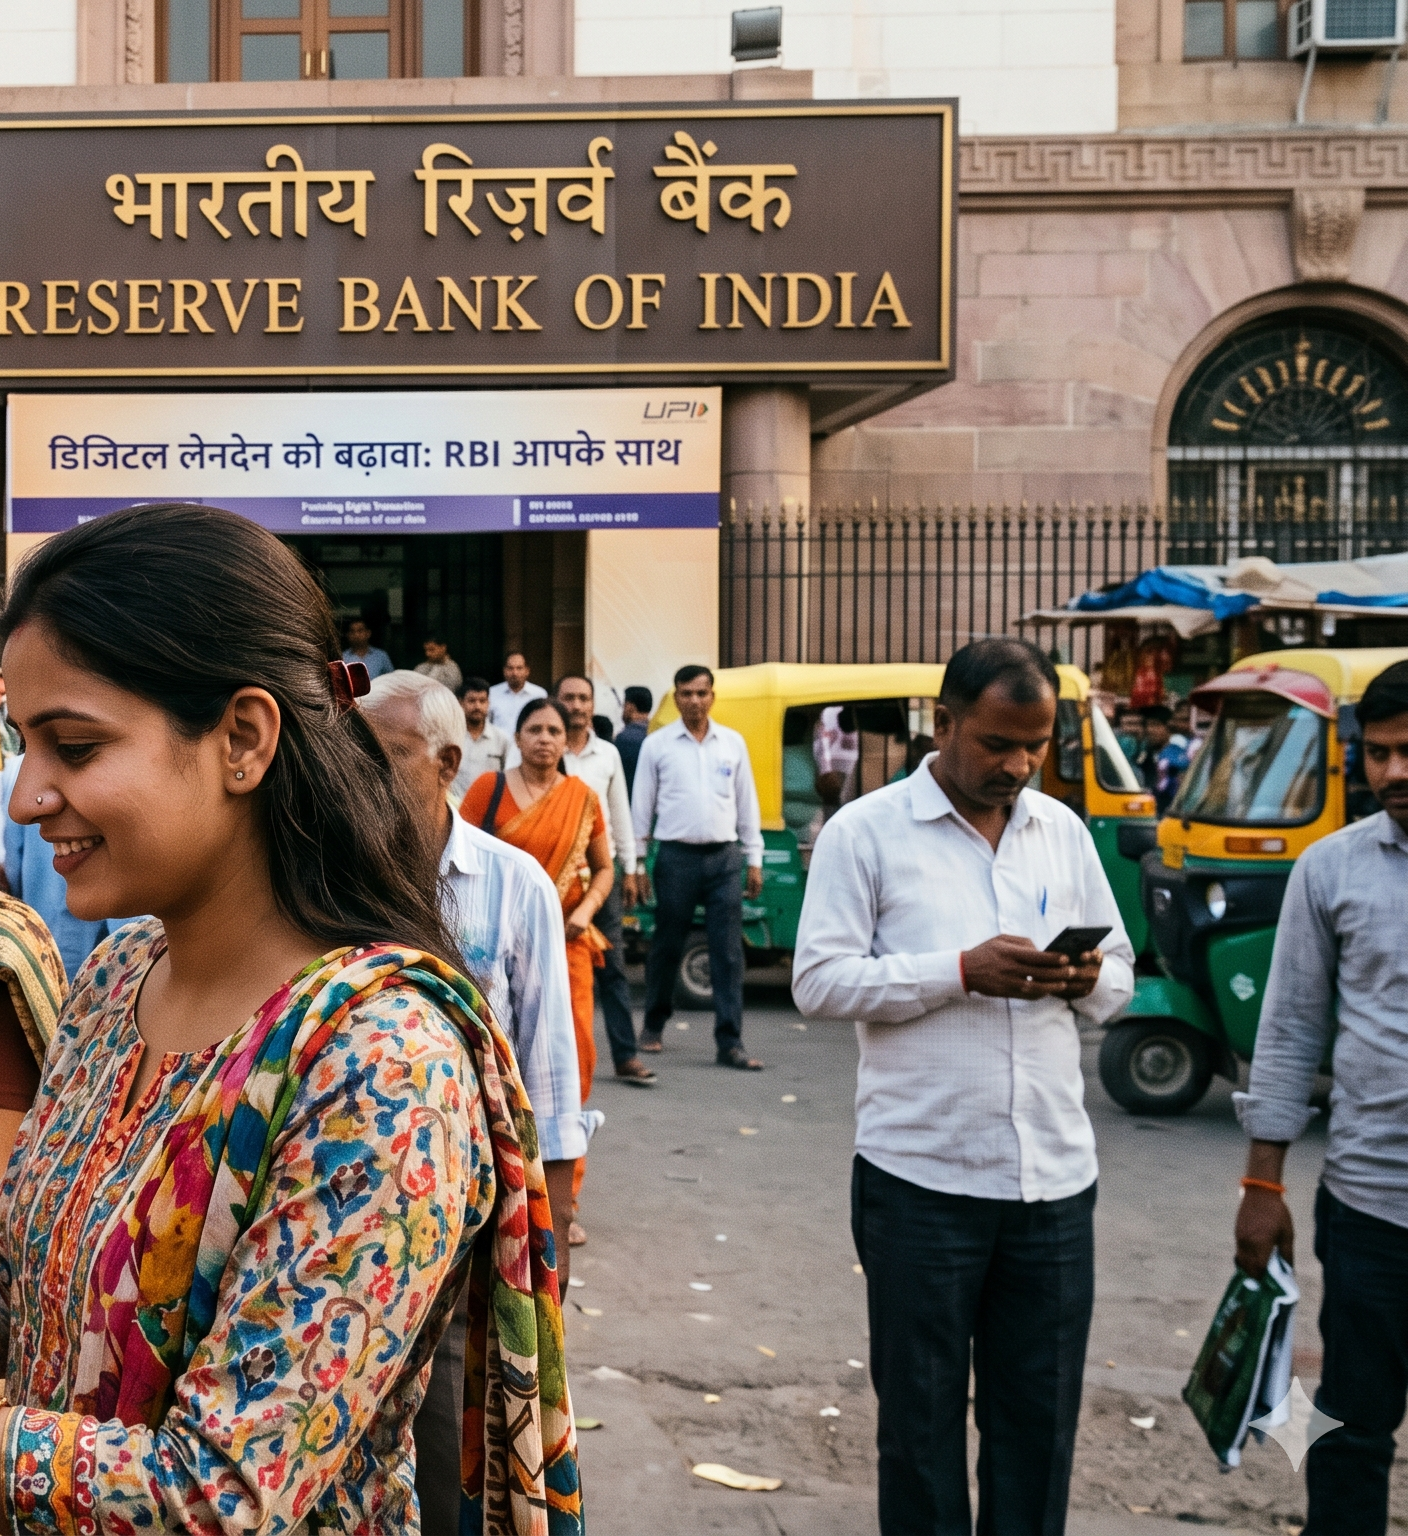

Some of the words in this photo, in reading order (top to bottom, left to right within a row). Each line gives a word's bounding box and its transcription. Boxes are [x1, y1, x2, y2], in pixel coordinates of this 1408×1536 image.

[105, 144, 376, 240] भारतीय
[414, 136, 615, 242] रिज़र्व
[652, 131, 798, 234] बैंक
[338, 275, 543, 333] BANK
[574, 273, 666, 330] OF
[698, 271, 912, 330] INDIA
[643, 401, 697, 419] UPI
[48, 434, 169, 470] डिजिटल
[179, 433, 272, 472] लेनदेन
[283, 433, 323, 469] को
[334, 441, 431, 476] बढ़ावा:
[445, 440, 500, 467] RBI
[512, 430, 605, 467] आपके
[615, 438, 683, 467] साथ
